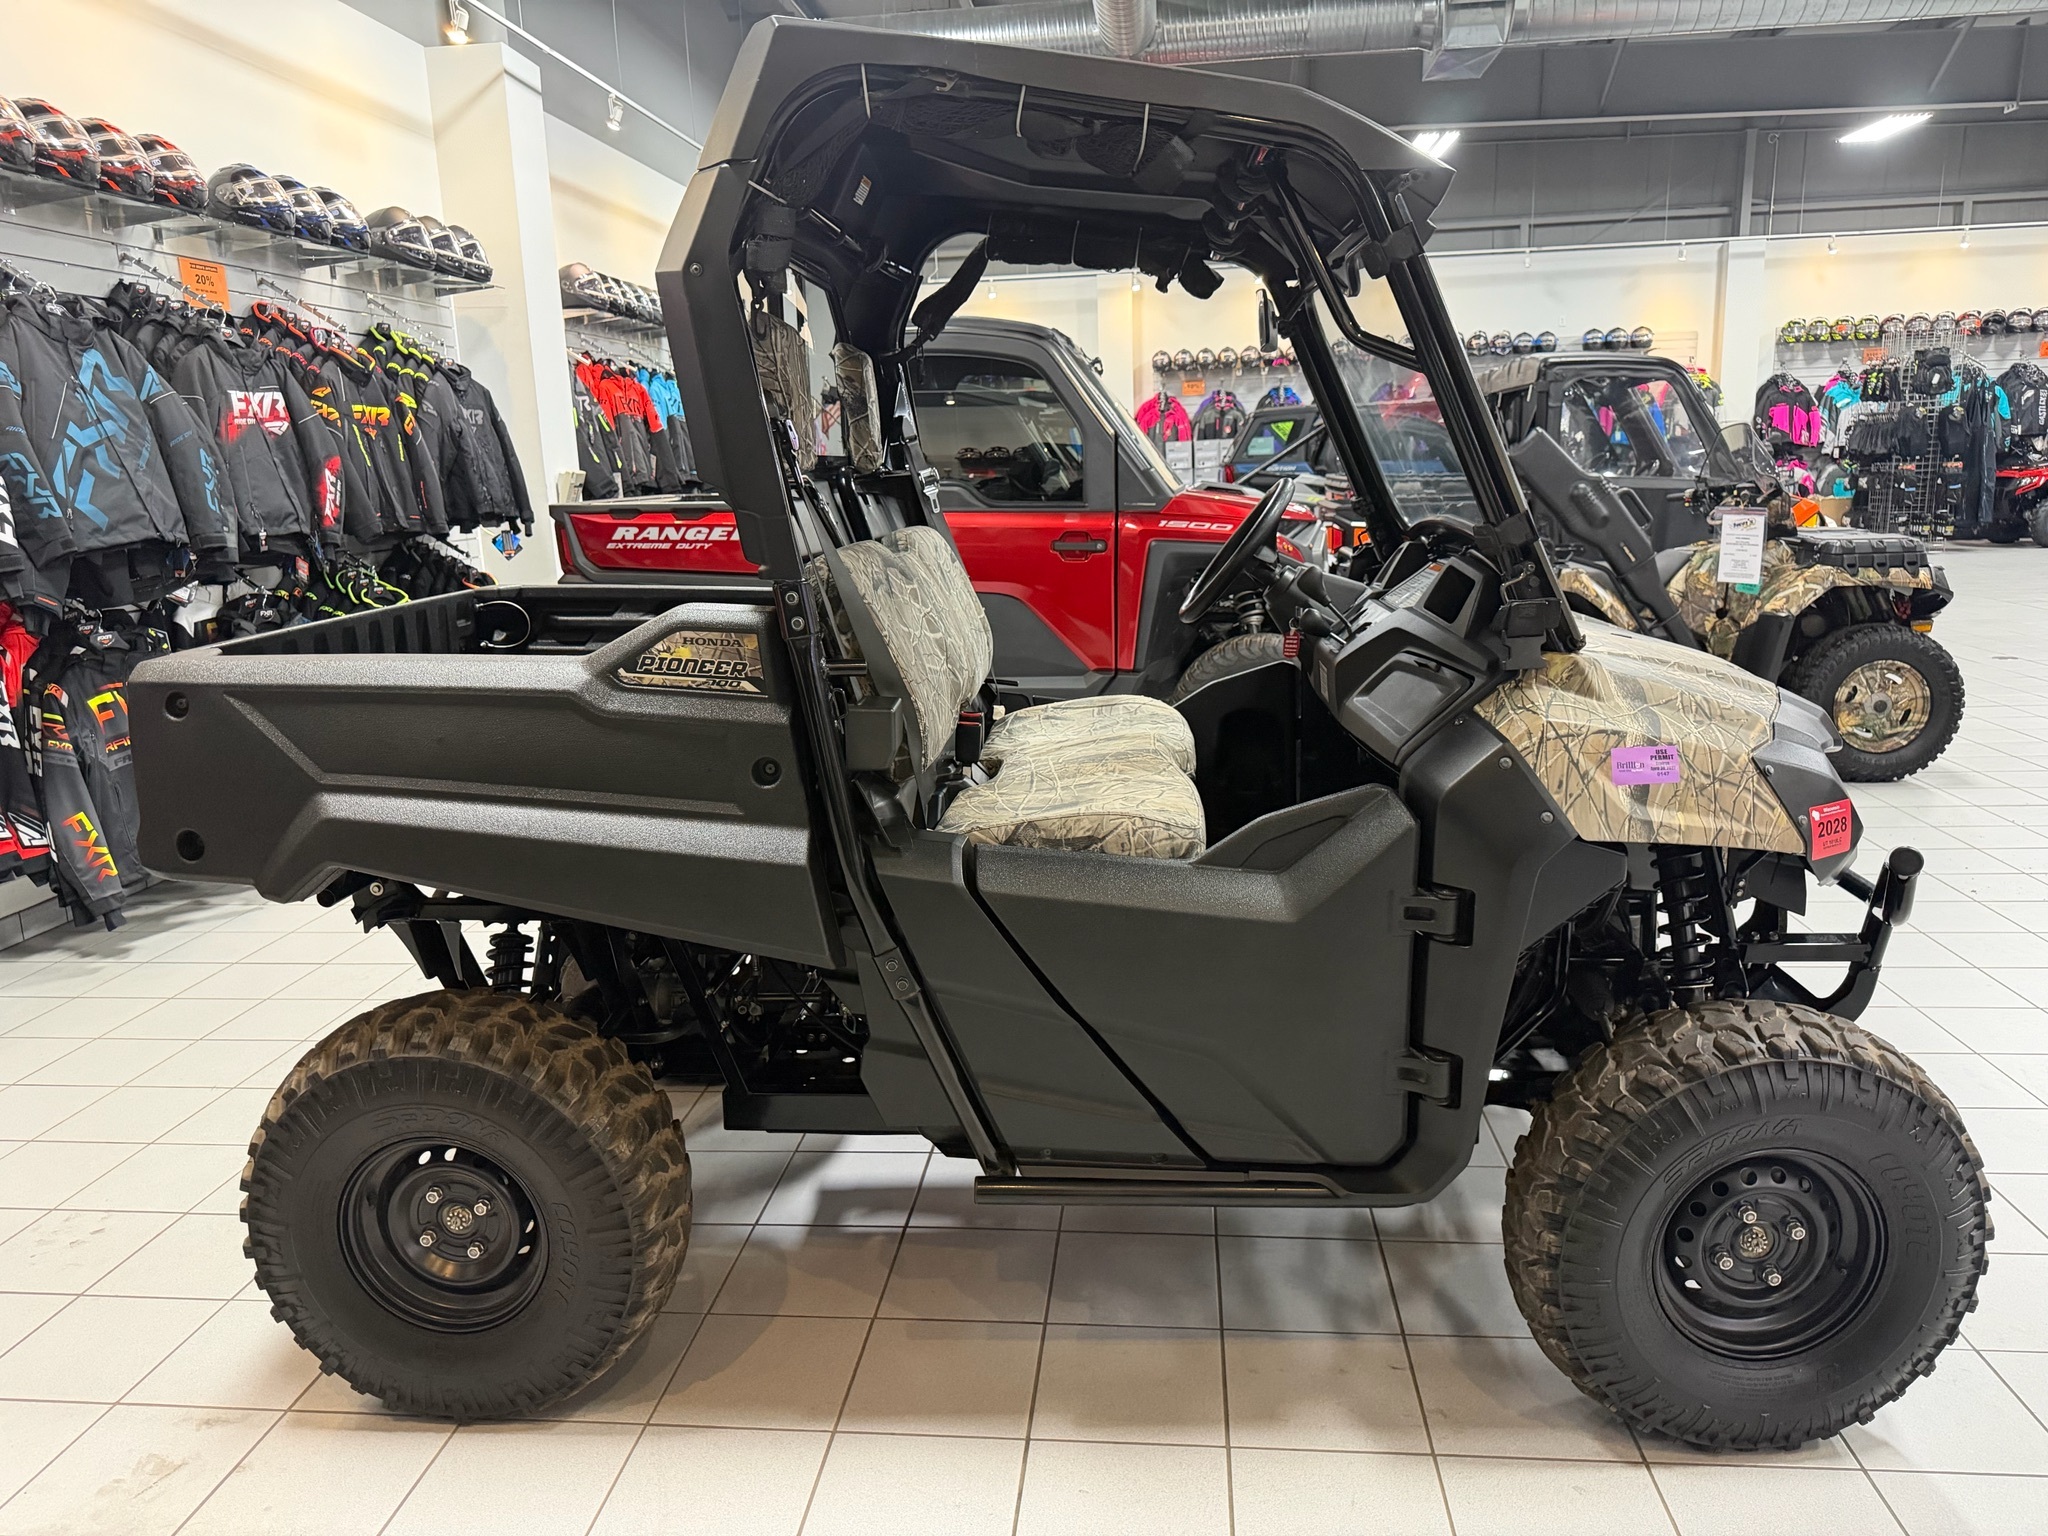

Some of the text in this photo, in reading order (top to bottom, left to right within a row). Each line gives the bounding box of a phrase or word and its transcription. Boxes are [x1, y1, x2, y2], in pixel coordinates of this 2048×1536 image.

[195, 273, 214, 286] 20%
[1158, 520, 1234, 531] 1500
[612, 527, 740, 541] RANGE
[682, 637, 743, 647] HONDA
[636, 655, 749, 677] PIONEER
[47, 740, 73, 751] FXR
[1818, 816, 1848, 838] 2028
[61, 811, 119, 882] FXR
